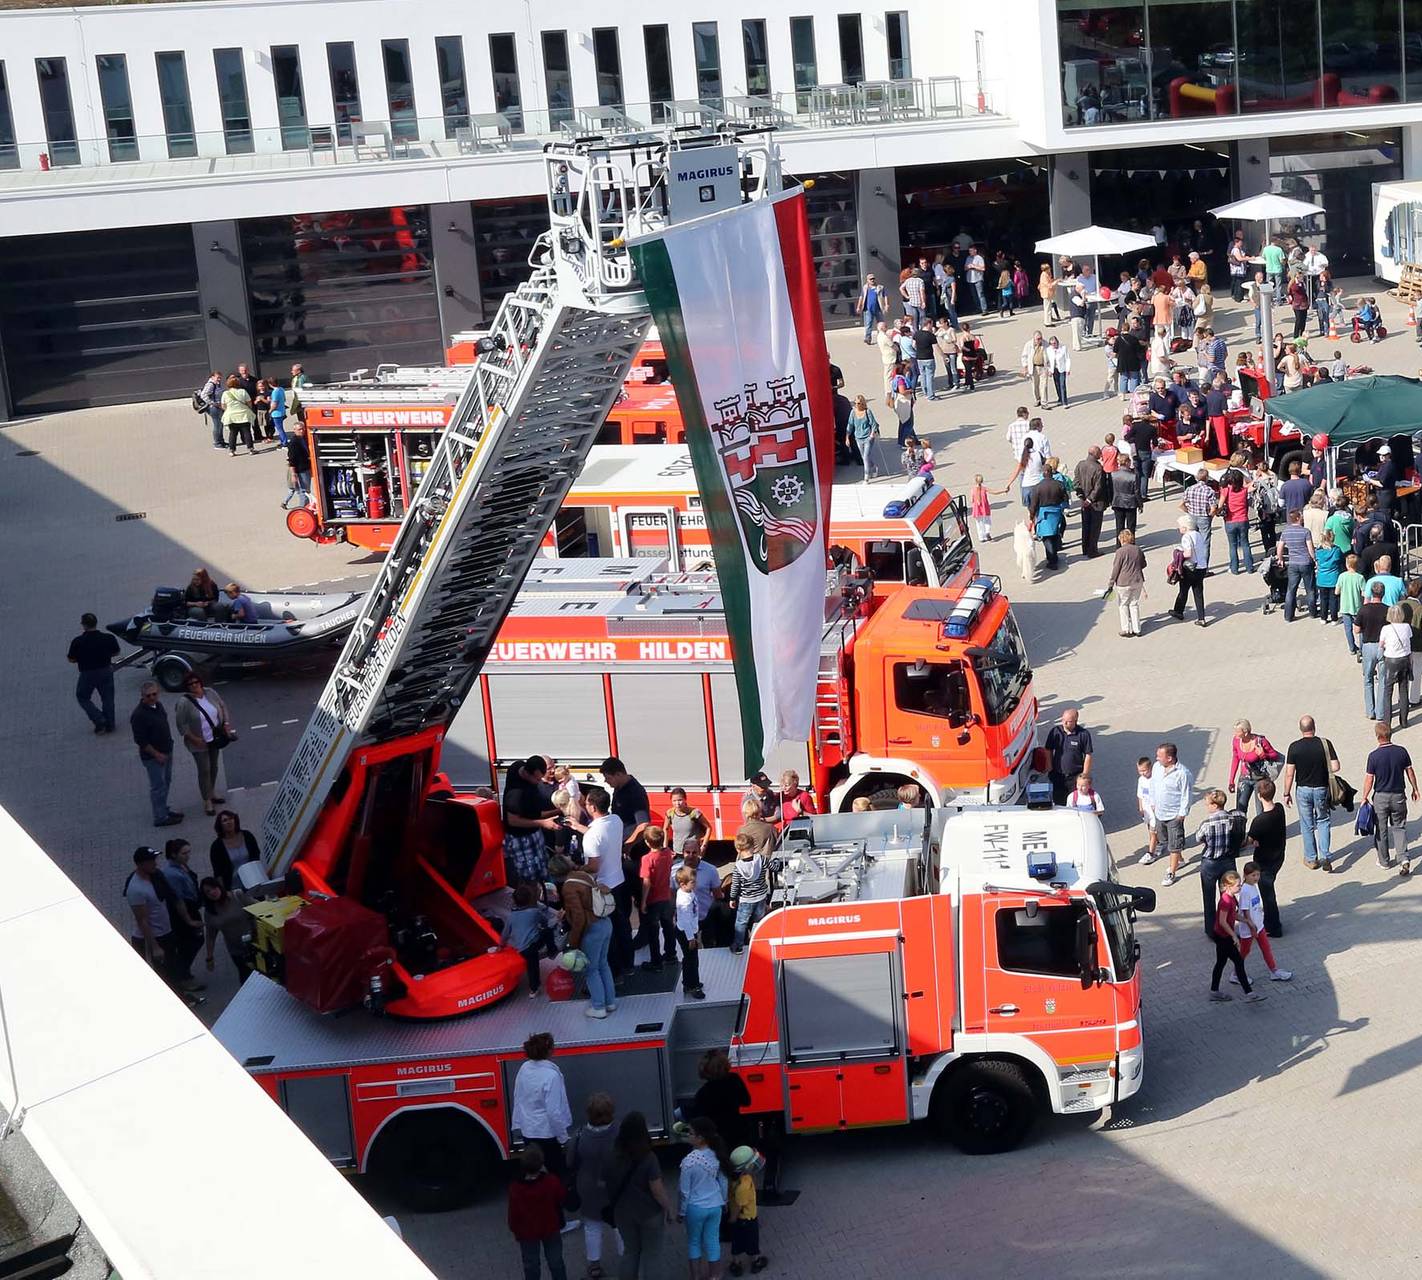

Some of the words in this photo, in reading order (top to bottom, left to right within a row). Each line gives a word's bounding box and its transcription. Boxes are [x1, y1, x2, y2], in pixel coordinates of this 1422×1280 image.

[677, 166, 734, 182] MAGIRUS
[340, 411, 445, 425] FEUERWEHR
[319, 608, 358, 631] TAUCHER
[178, 629, 233, 643] FEUERWEHR
[233, 632, 267, 644] HILDEN
[639, 641, 725, 660] HILDEN
[344, 654, 385, 734] FEUERWEHR
[380, 611, 408, 664] HILDEN
[1021, 830, 1048, 851] ME
[807, 914, 862, 927] MAGIRUS
[457, 984, 505, 1009] MAGIRUS
[397, 1063, 453, 1076] MAGIRUS
